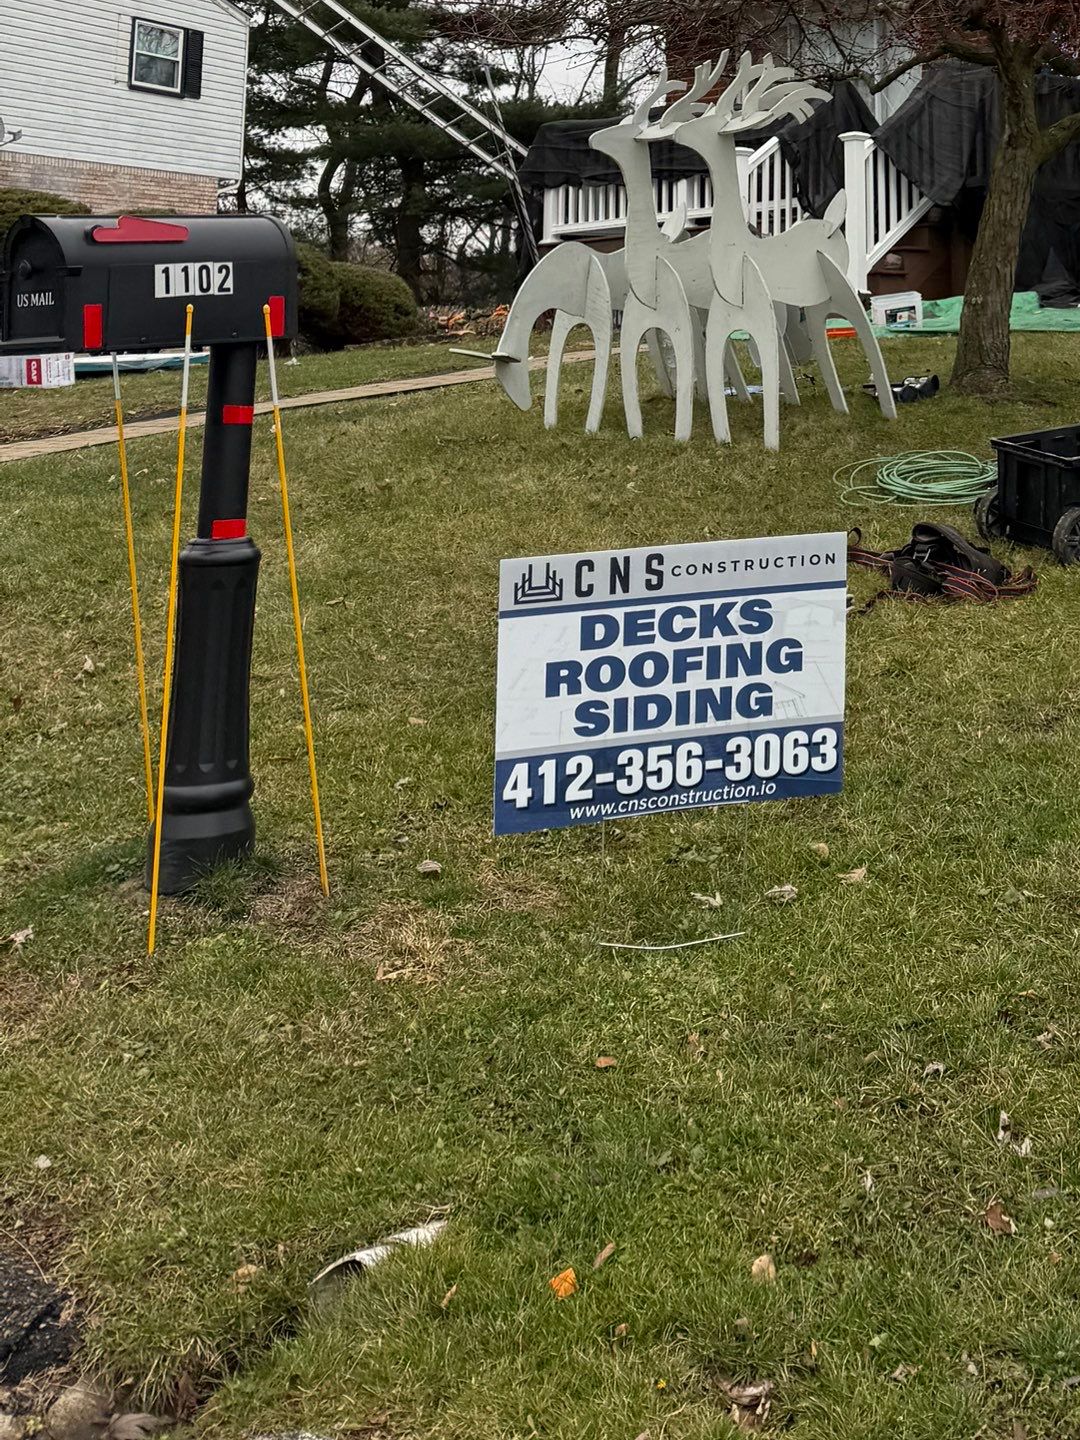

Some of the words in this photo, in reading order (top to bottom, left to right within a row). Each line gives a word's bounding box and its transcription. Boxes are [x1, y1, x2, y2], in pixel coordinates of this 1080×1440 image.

[16, 293, 29, 308] US
[30, 291, 55, 307] MAIL
[161, 263, 232, 295] 1102
[574, 553, 665, 598] CNS
[671, 552, 836, 578] CONSTRUCTION
[579, 598, 774, 652] DECKS
[544, 637, 804, 699] ROOFING
[572, 682, 774, 738] SIDING
[501, 727, 838, 810] 412-356-3063
[568, 779, 777, 820] www.cnsconstruction.io
